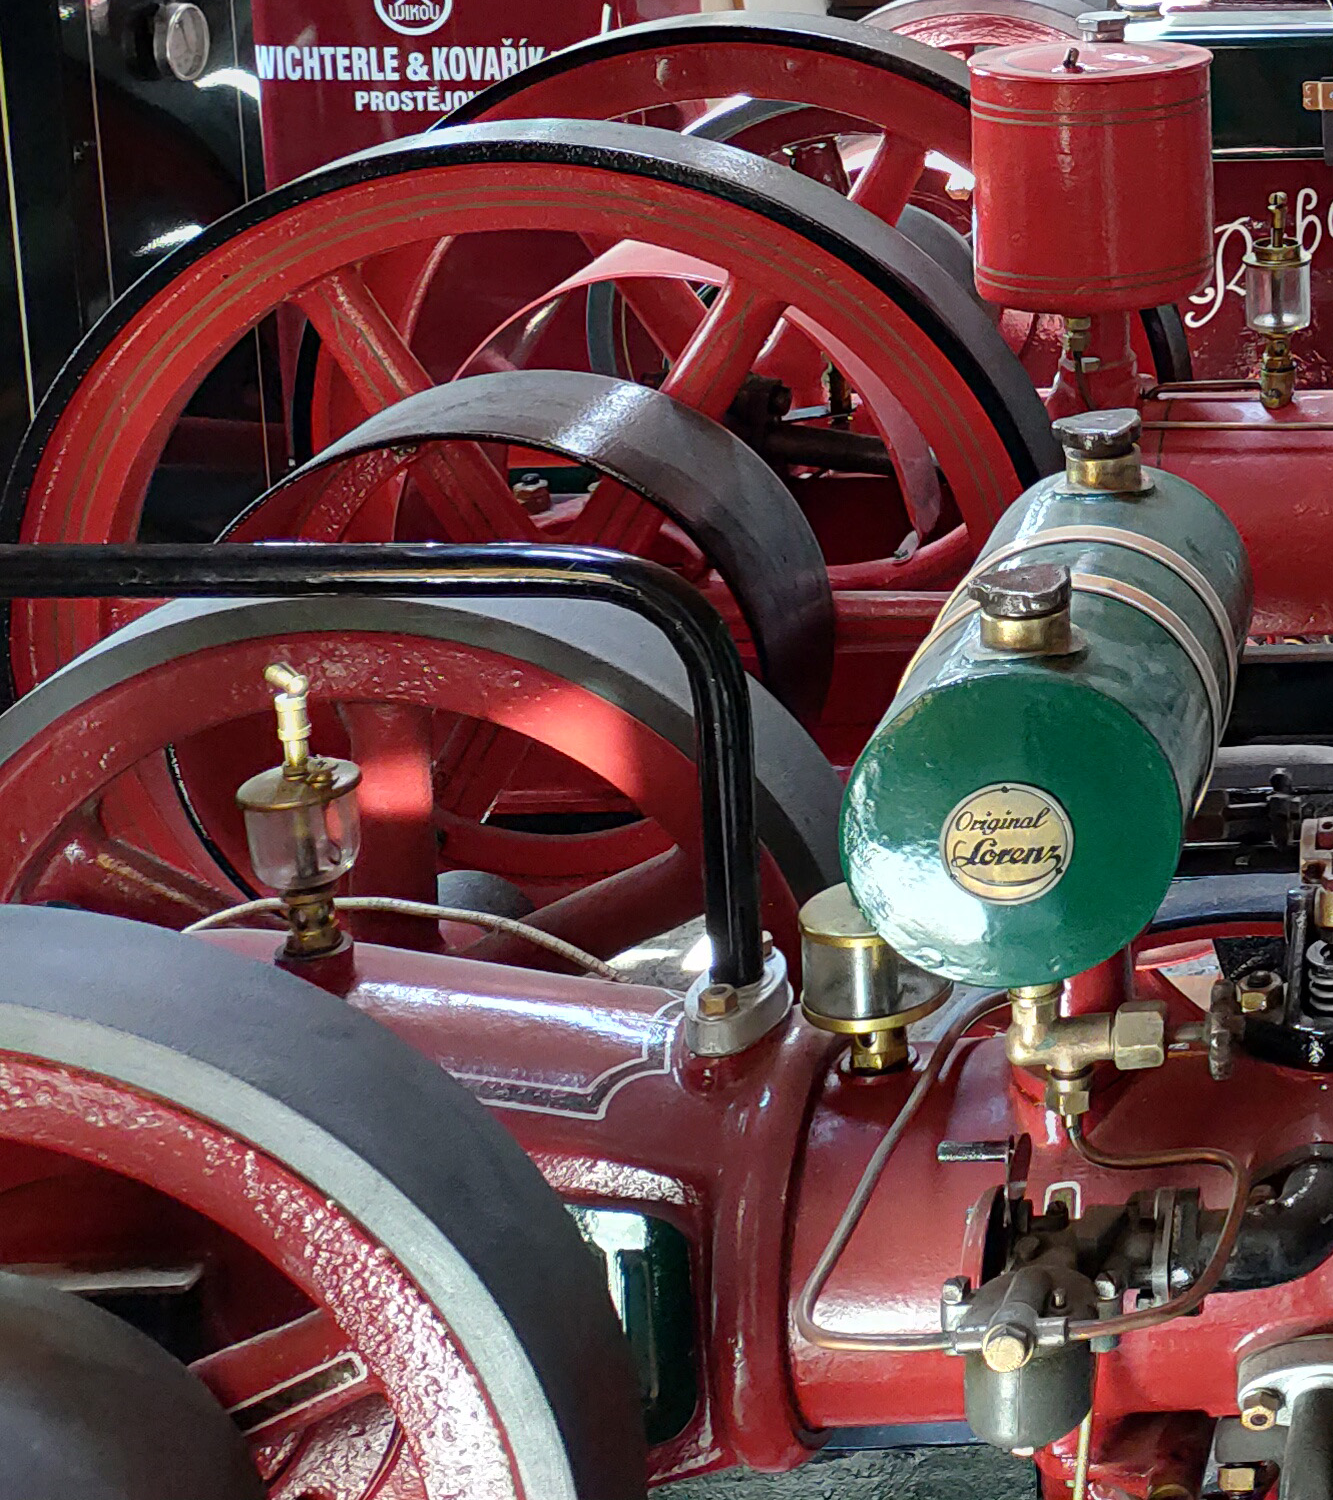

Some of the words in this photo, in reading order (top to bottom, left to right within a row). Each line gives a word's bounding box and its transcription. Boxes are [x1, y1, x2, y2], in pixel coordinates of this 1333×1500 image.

[388, 3, 441, 21] WIKOV
[254, 44, 400, 81] WICHTERLE
[405, 51, 431, 82] &
[955, 806, 1051, 836] Original
[950, 837, 1063, 874] Lorenz
